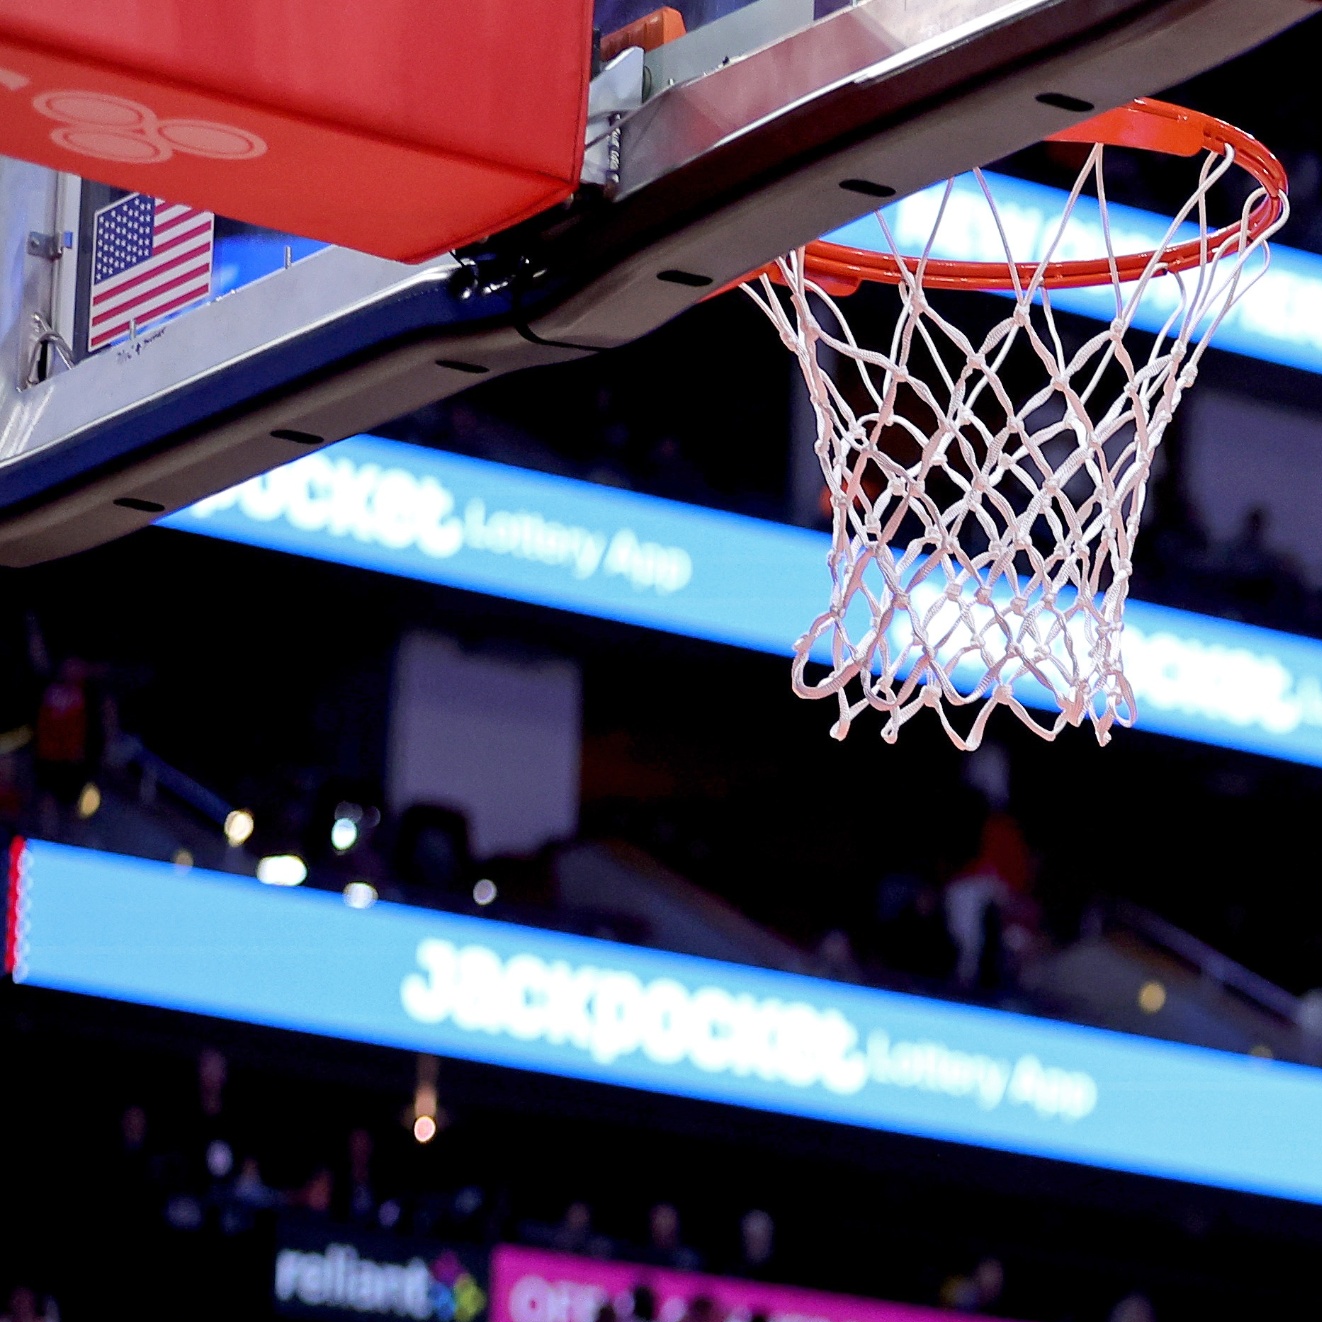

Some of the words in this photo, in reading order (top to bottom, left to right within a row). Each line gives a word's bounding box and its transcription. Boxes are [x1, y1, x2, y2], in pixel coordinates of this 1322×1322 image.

[866, 1028, 1010, 1111] Lottery
[1008, 1053, 1097, 1124] App
[276, 1243, 434, 1321] reliant
